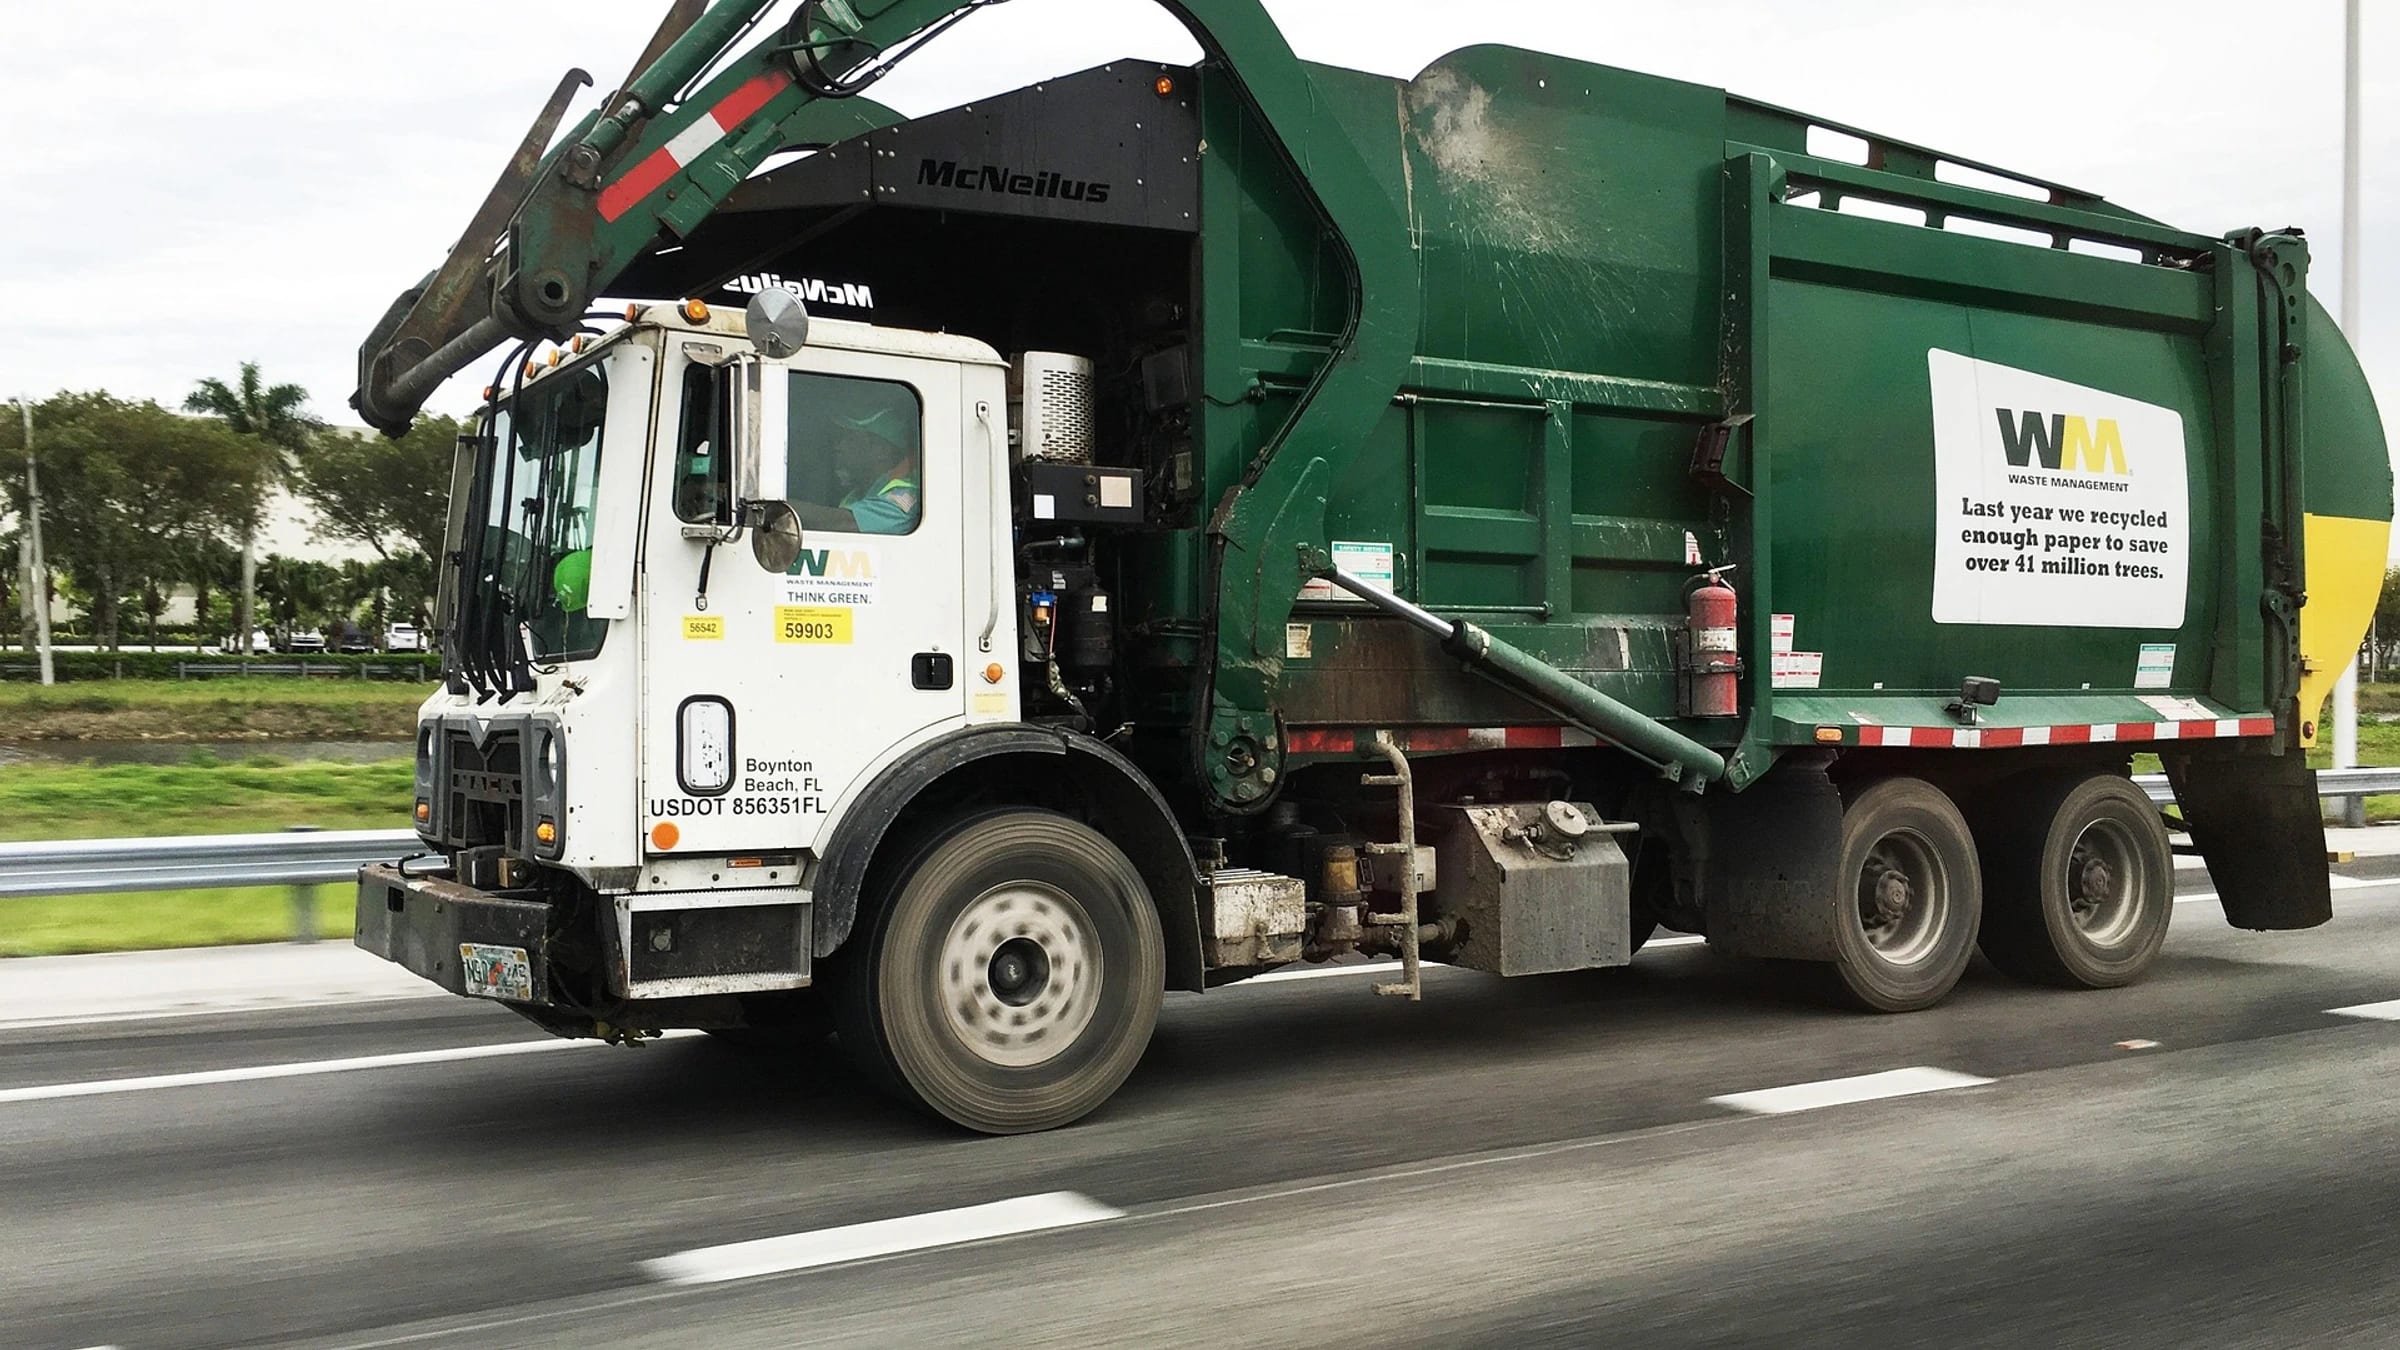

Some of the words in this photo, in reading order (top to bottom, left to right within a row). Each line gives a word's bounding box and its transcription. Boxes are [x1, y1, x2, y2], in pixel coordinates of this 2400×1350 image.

[917, 159, 1111, 203] McNeilus
[1995, 407, 2128, 476] WM
[2008, 474, 2048, 487] WASTE
[2051, 477, 2129, 492] MANAGEMENT
[1961, 497, 2004, 517] Last
[2010, 504, 2054, 524] year
[2058, 508, 2085, 523] we
[2090, 509, 2168, 530] recycled
[1961, 528, 2038, 551] enough
[2044, 533, 2100, 553] paper
[2105, 534, 2124, 551] to
[2129, 538, 2168, 554] save
[1965, 556, 2010, 572] over
[2015, 554, 2035, 573] 41
[2041, 556, 2110, 576] million
[2115, 561, 2164, 579] trees.
[816, 580, 873, 588] MANAGEMENT
[787, 591, 826, 603] THINK
[828, 592, 872, 605] GREEN.
[690, 622, 717, 633] 56542
[785, 622, 833, 639] 59903
[746, 758, 813, 775] Boynton
[744, 778, 799, 793] Beach,
[804, 778, 823, 792] FL
[650, 798, 726, 817] USDOT
[732, 796, 827, 815] 856351FL
